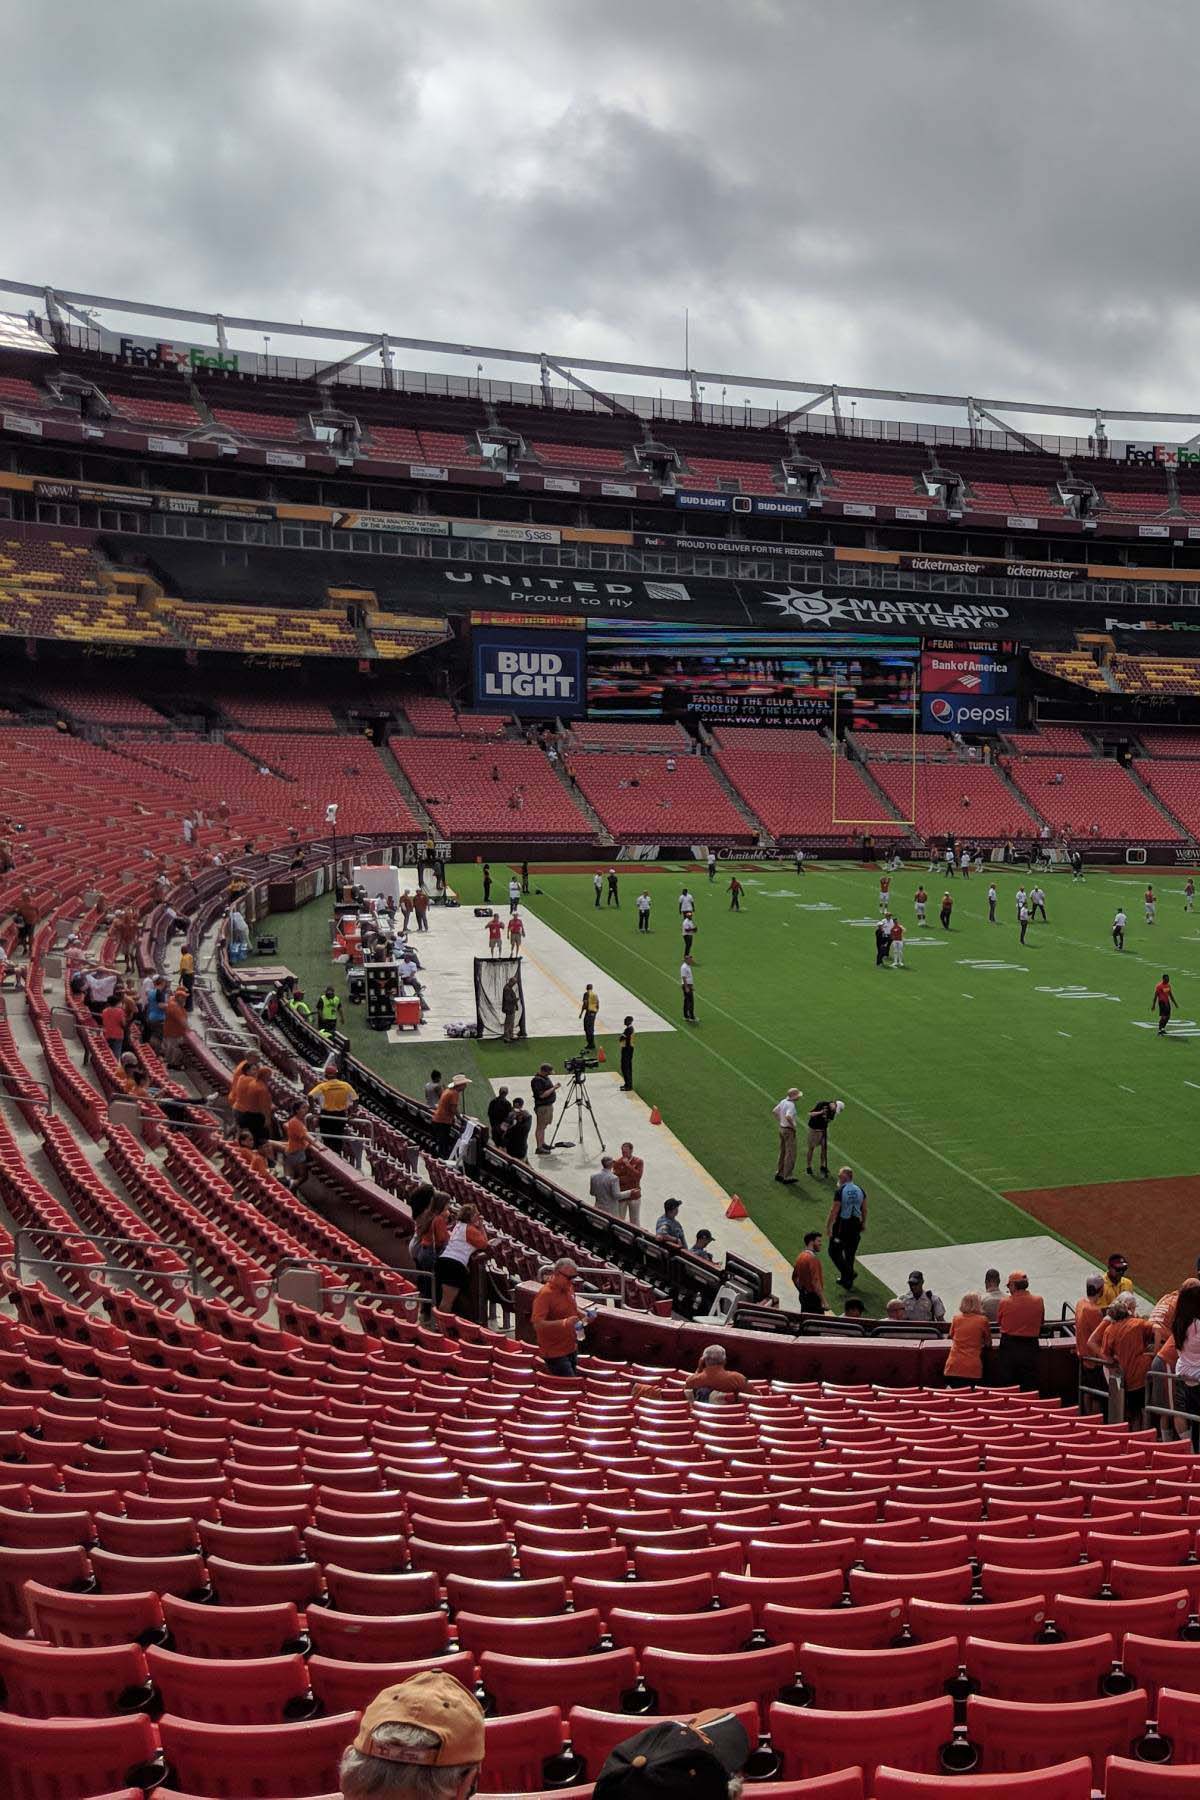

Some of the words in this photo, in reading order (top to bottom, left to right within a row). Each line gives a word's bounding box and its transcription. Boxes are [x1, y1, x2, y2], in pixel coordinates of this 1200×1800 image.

[680, 495, 699, 506] BUD
[700, 497, 727, 508] LIGHT
[758, 502, 777, 512] BUD
[777, 503, 803, 513] LIGHT
[676, 540, 706, 550] PROUD
[706, 542, 717, 550] TO
[717, 543, 750, 553] DELIVER
[751, 544, 768, 553] FOR
[768, 546, 783, 554] THE
[911, 558, 981, 574] ticketmaster
[1007, 564, 1075, 580] ticketmaster
[443, 570, 633, 594] UNITED
[511, 591, 572, 604] Proud
[580, 596, 603, 606] to
[608, 596, 633, 609] fly
[848, 597, 1010, 618] MARYLAND
[854, 609, 985, 629] LOTTERY
[497, 651, 563, 675] BUD
[931, 659, 957, 670] Bank
[958, 661, 968, 671] of
[968, 661, 1008, 673] America
[485, 673, 575, 698] LIGHT
[957, 706, 1010, 725] pepsi
